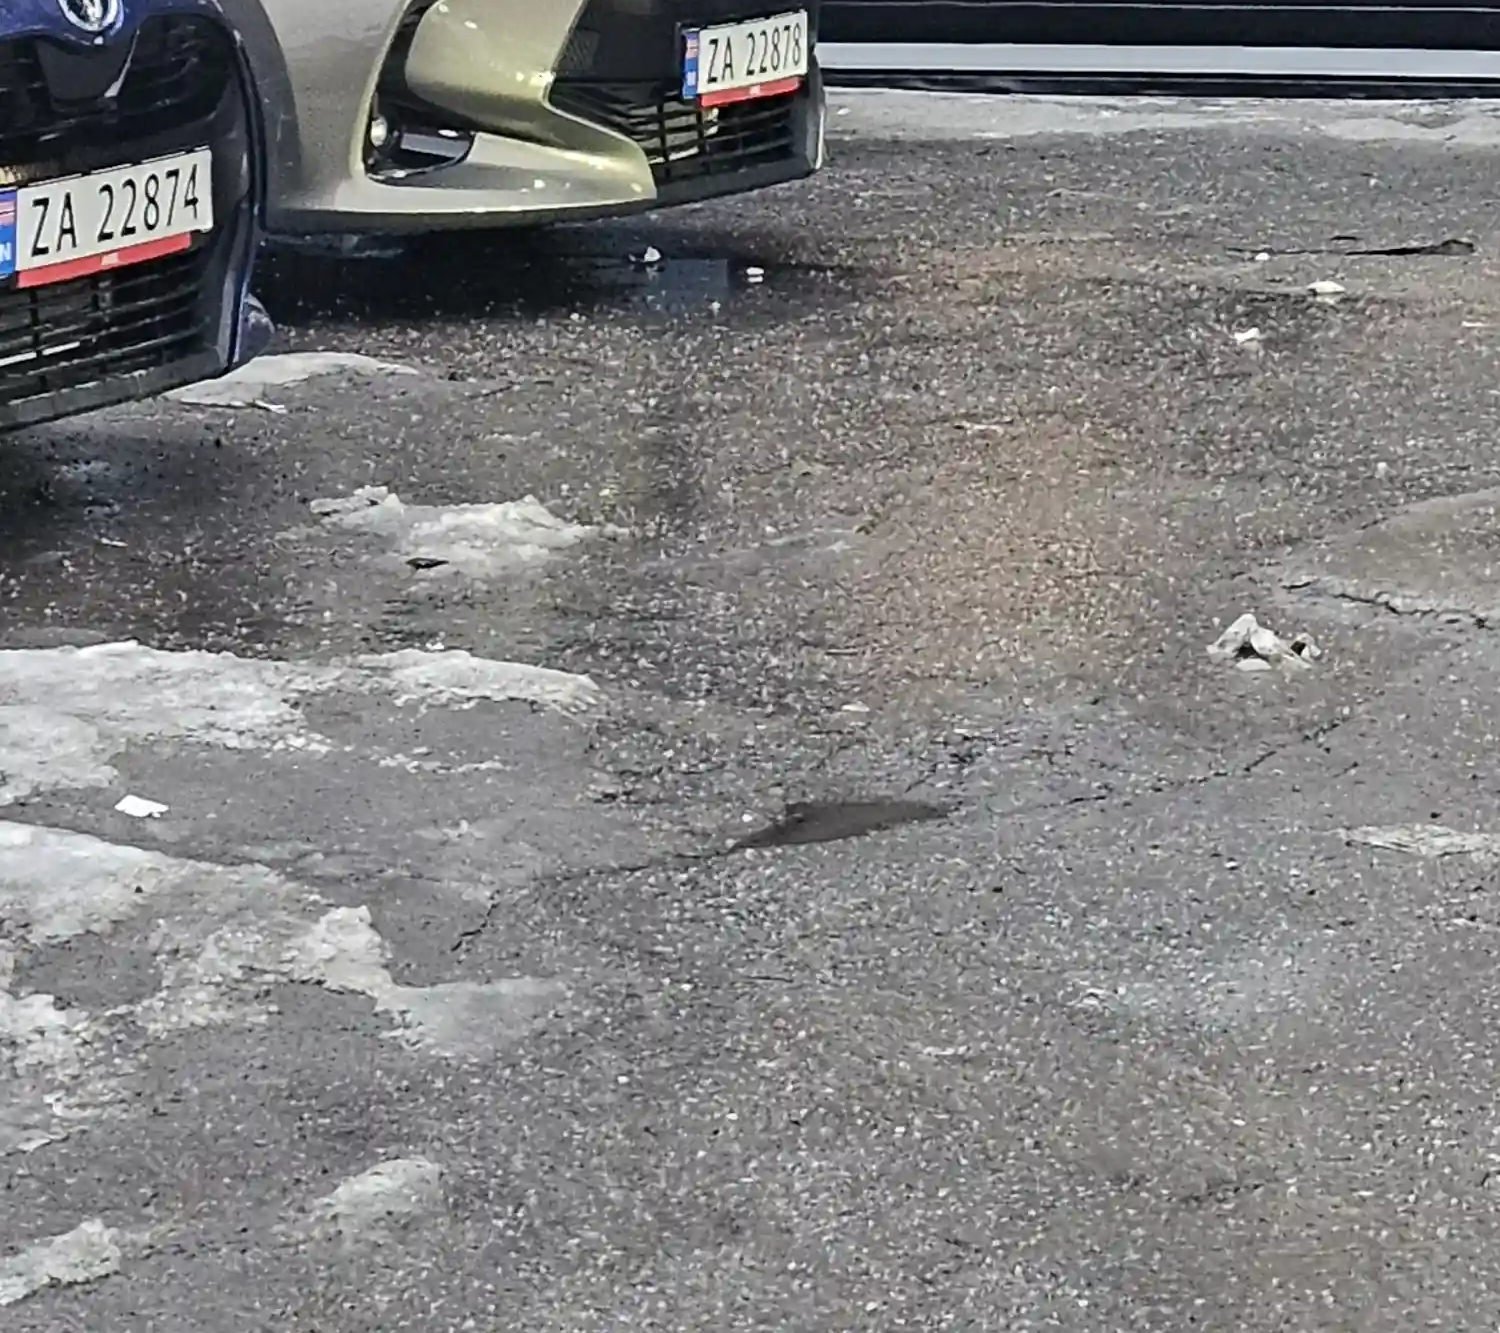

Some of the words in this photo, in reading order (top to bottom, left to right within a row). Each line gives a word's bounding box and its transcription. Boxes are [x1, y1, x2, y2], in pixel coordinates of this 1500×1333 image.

[707, 37, 734, 83] ZA
[746, 23, 801, 76] 22878
[32, 192, 76, 257] ZA
[98, 164, 198, 241] 22874
